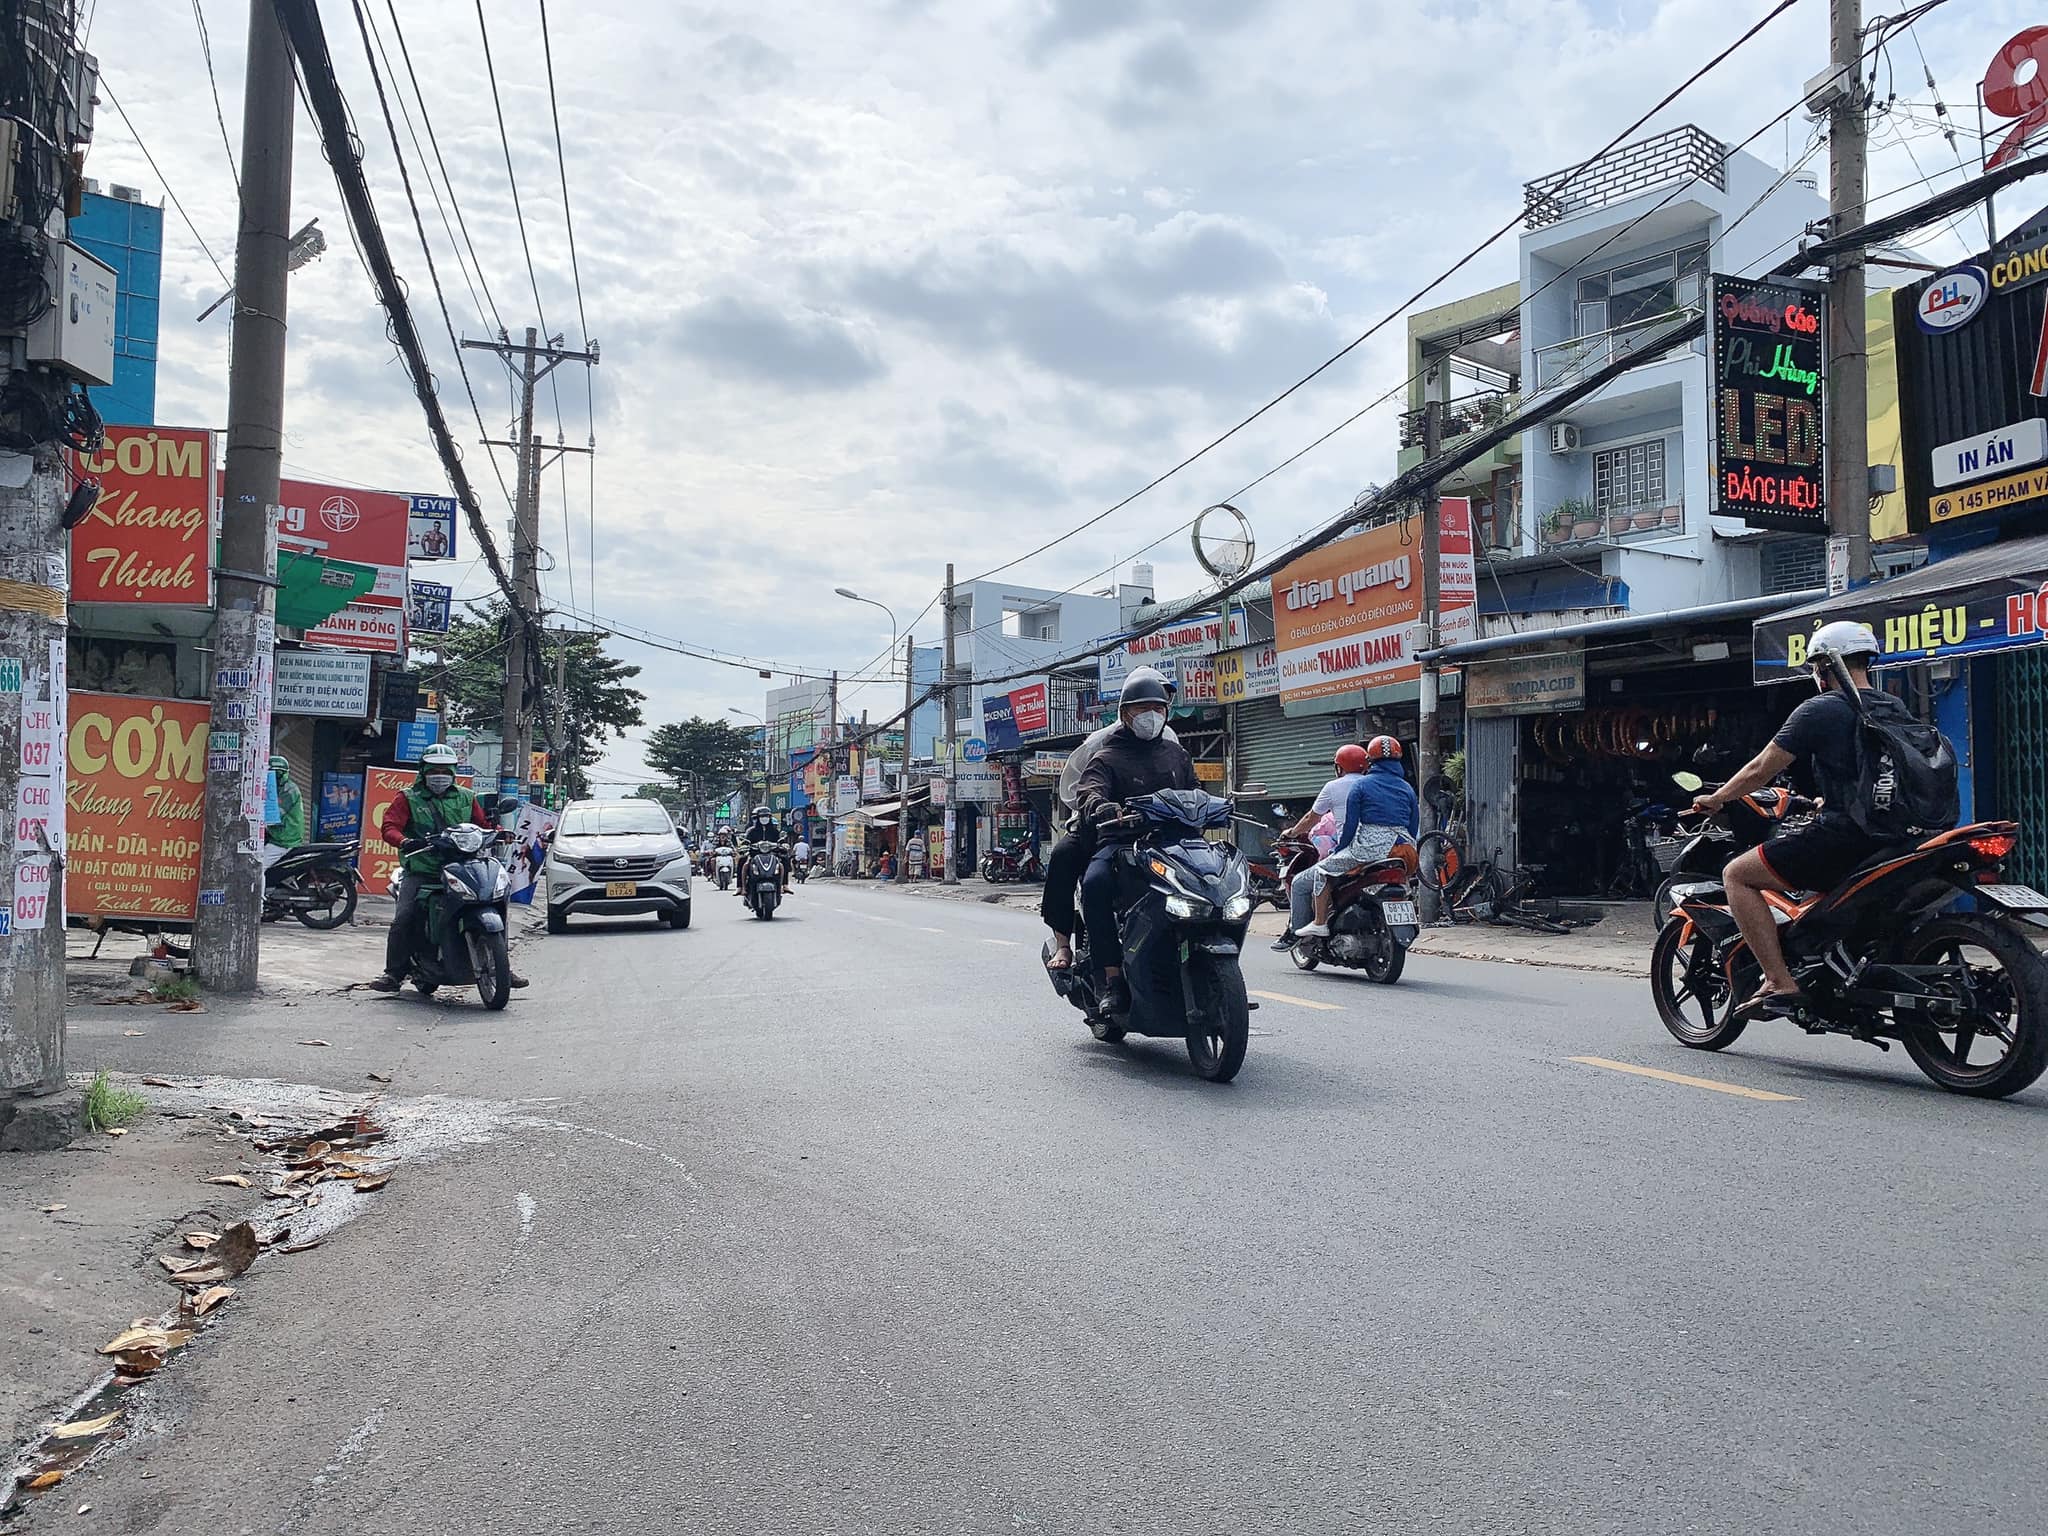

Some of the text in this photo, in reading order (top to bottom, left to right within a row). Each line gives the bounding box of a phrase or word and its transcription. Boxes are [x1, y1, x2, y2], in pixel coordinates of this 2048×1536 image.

[1784, 303, 1816, 333] Cáo
[1724, 388, 1818, 467] LED
[80, 432, 202, 478] CƠM
[1958, 435, 2014, 474] IN ẤN
[419, 499, 450, 510] GYM
[1727, 465, 1817, 511] BẢNG HIỆU
[1958, 492, 1983, 511] 145
[1987, 480, 2029, 504] PHẠM
[80, 487, 205, 541] Khang
[86, 548, 196, 598] Thịnh
[422, 586, 448, 596] GYM
[1279, 555, 1411, 611] điện quang
[1885, 604, 1967, 656] HIỆU
[1318, 643, 1364, 675] THANH
[1364, 634, 1404, 665] DANH
[68, 705, 209, 783] CƠM
[376, 773, 414, 790] Khan
[1874, 769, 1898, 811] YONEX
[66, 780, 204, 828] Khang Thịnh
[66, 826, 200, 862] HẦN DĨA HỘP
[154, 863, 196, 883] NGHIỆP
[16, 896, 46, 920] 037
